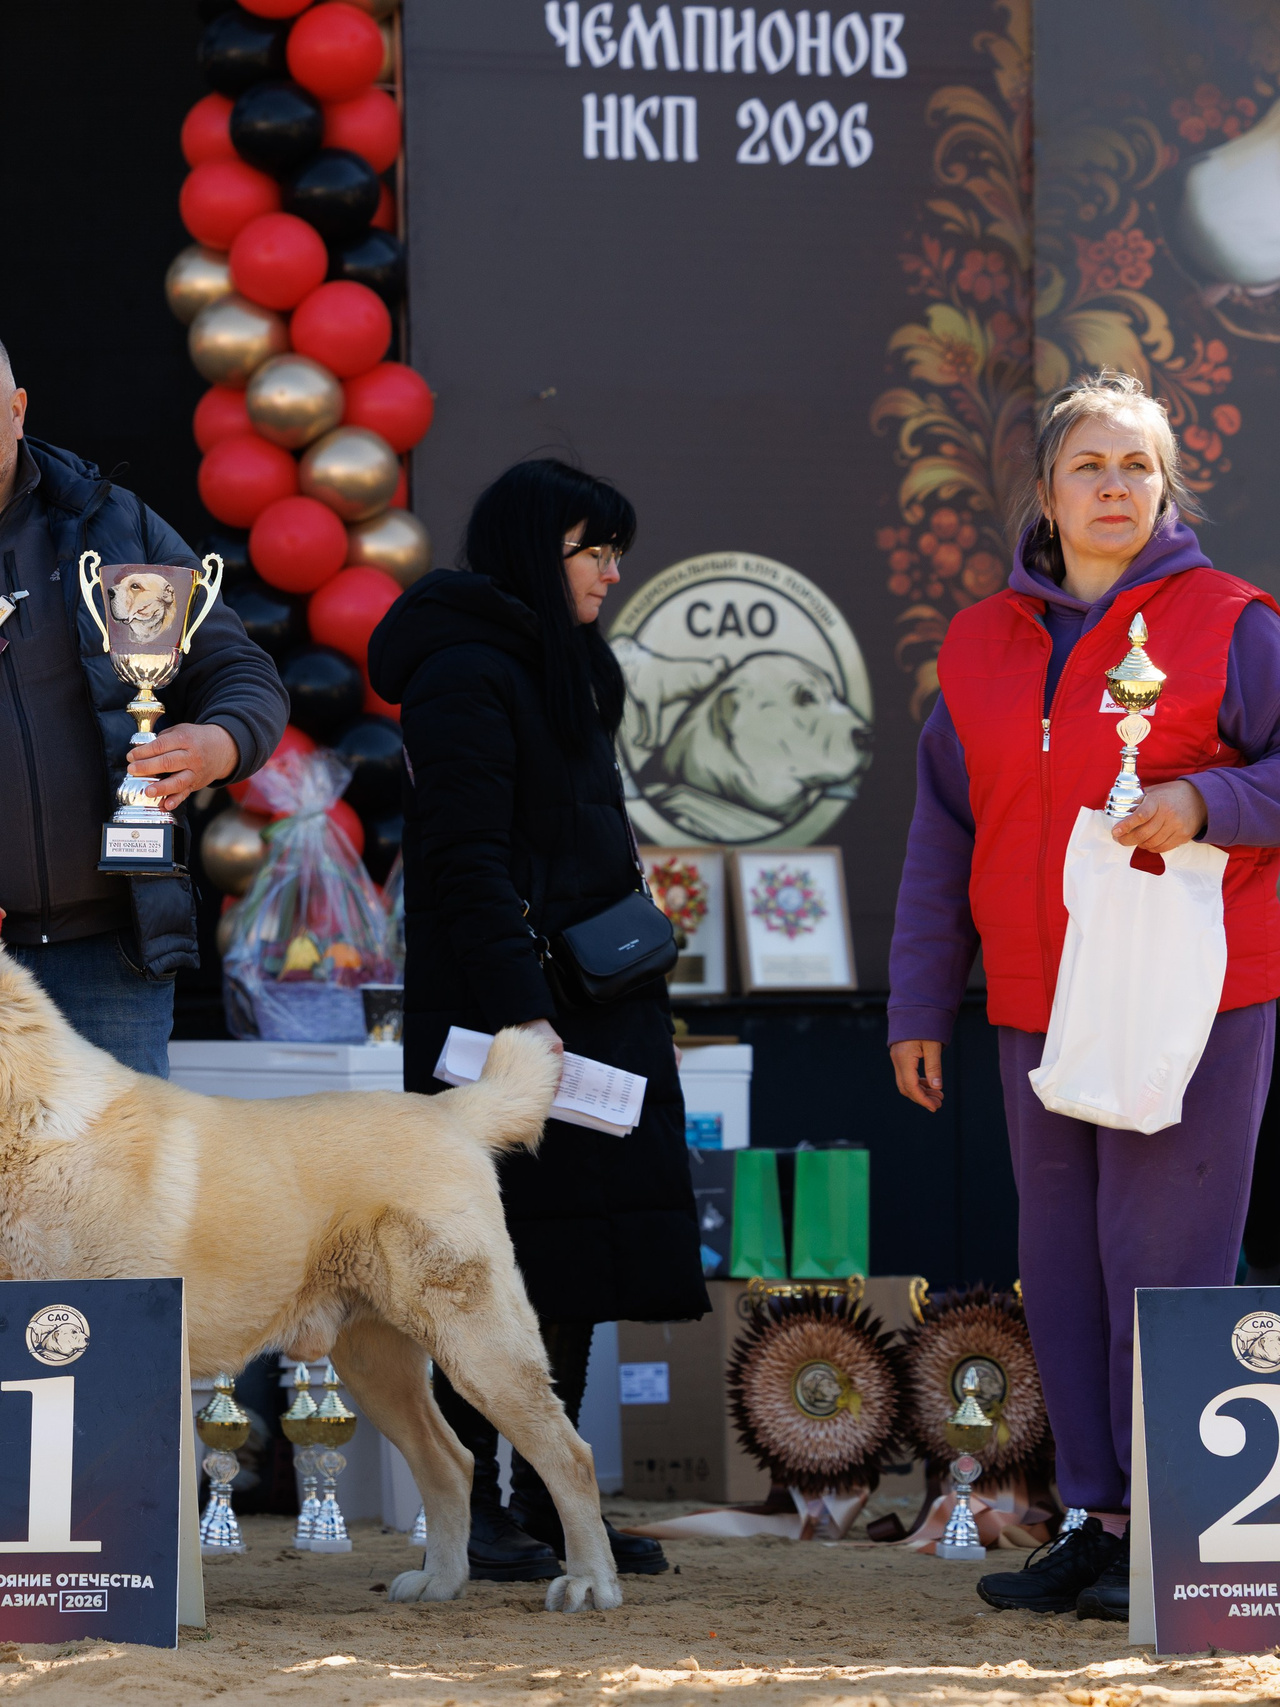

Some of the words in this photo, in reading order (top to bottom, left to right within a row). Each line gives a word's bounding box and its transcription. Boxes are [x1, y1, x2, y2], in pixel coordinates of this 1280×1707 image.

[545, 1, 908, 79] ЧЕМПИОНОВ
[582, 93, 699, 163] НКП
[735, 98, 874, 168] 2026
[686, 601, 777, 638] САО
[47, 1313, 69, 1322] САО
[1251, 1320, 1274, 1329] САО
[1198, 1384, 1280, 1563] 2
[56, 1573, 154, 1589] ОТЕЧЕСТВА
[1173, 1583, 1278, 1600] ДОСТОЯНИЕ
[1, 1593, 58, 1607] АЗИАТ
[65, 1594, 103, 1608] 2026
